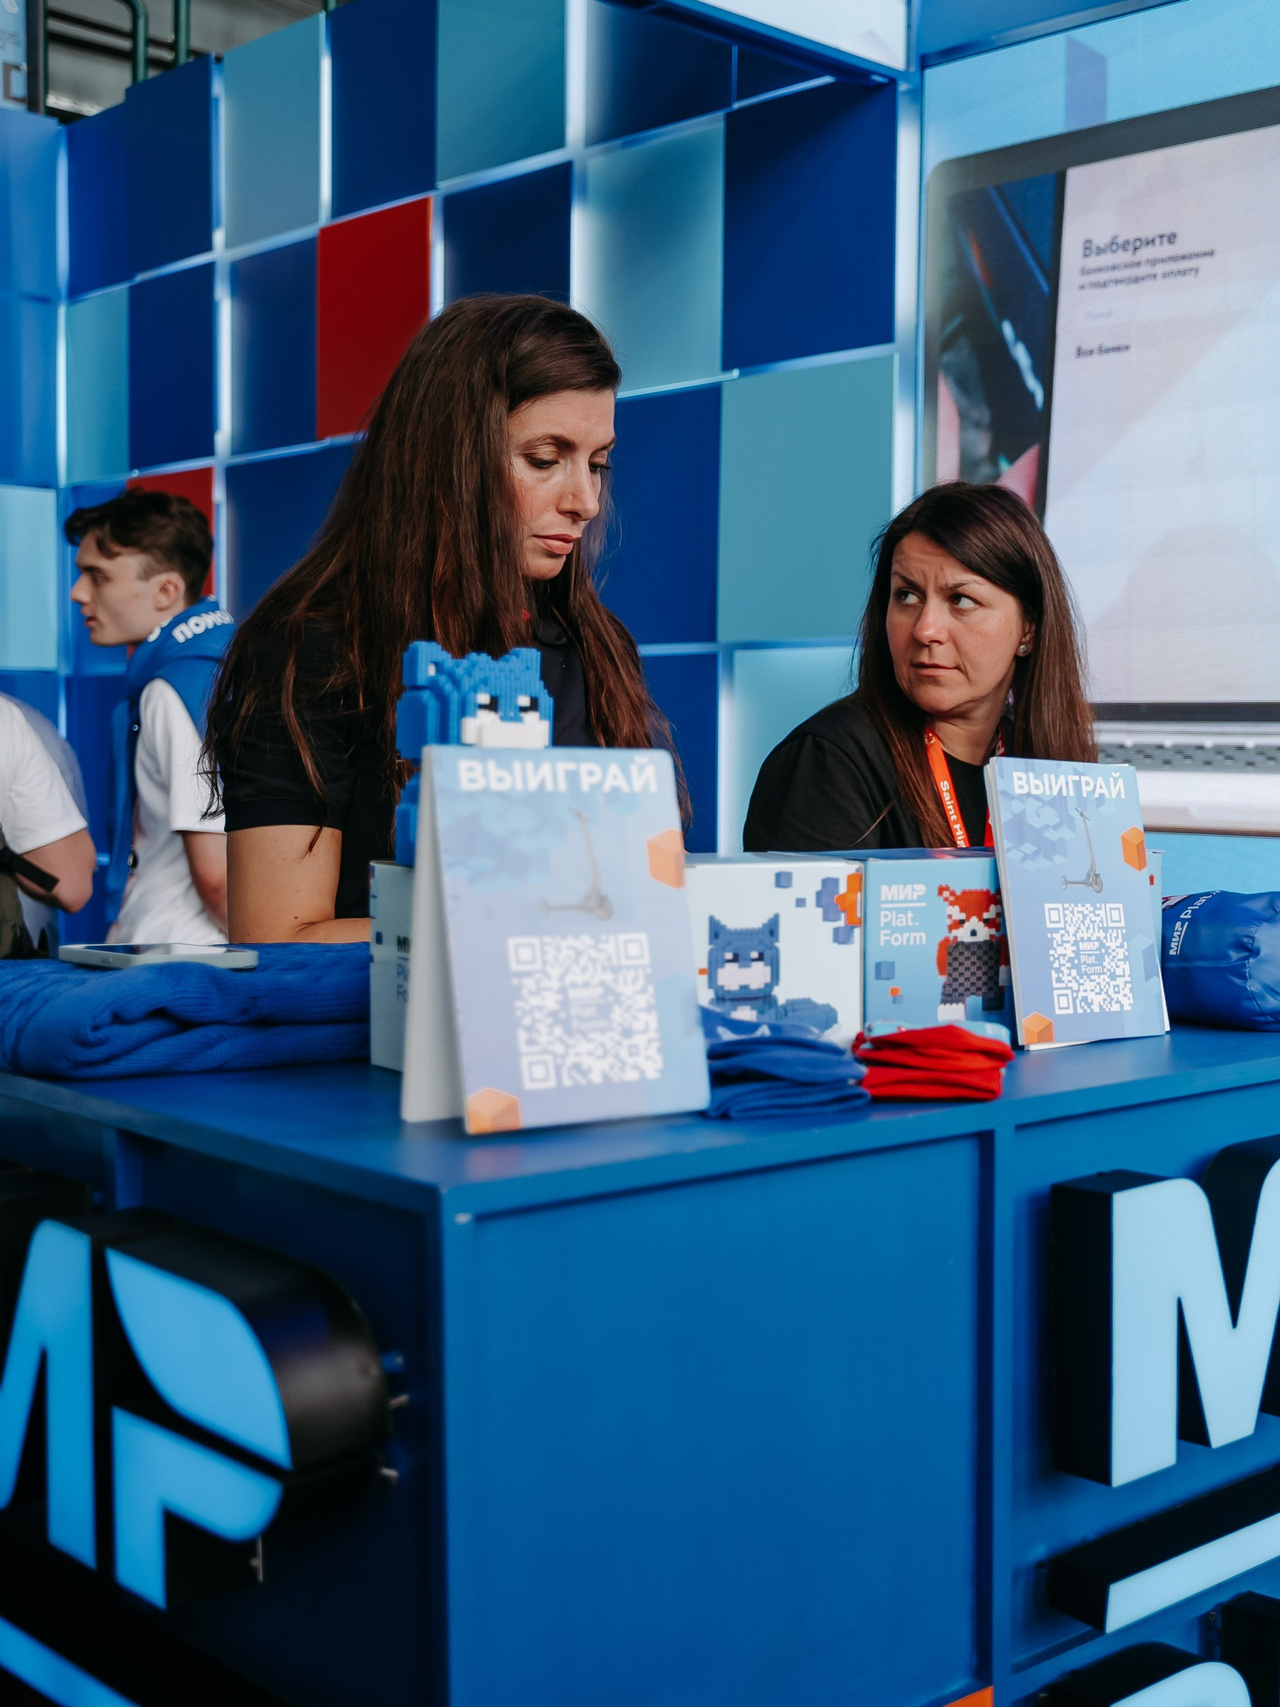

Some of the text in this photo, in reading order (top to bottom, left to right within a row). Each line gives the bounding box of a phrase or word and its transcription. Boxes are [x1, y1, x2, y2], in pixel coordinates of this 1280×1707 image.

[1083, 231, 1178, 259] Выберите
[457, 756, 659, 793] ВЫИГРАЙ
[1012, 771, 1127, 800] ВЫИГРАЙ
[940, 780, 957, 822] Saint
[880, 884, 926, 901] МИР
[880, 910, 919, 927] Plat.
[880, 929, 926, 947] Form
[1168, 921, 1183, 955] МИР
[1081, 964, 1103, 974] Form
